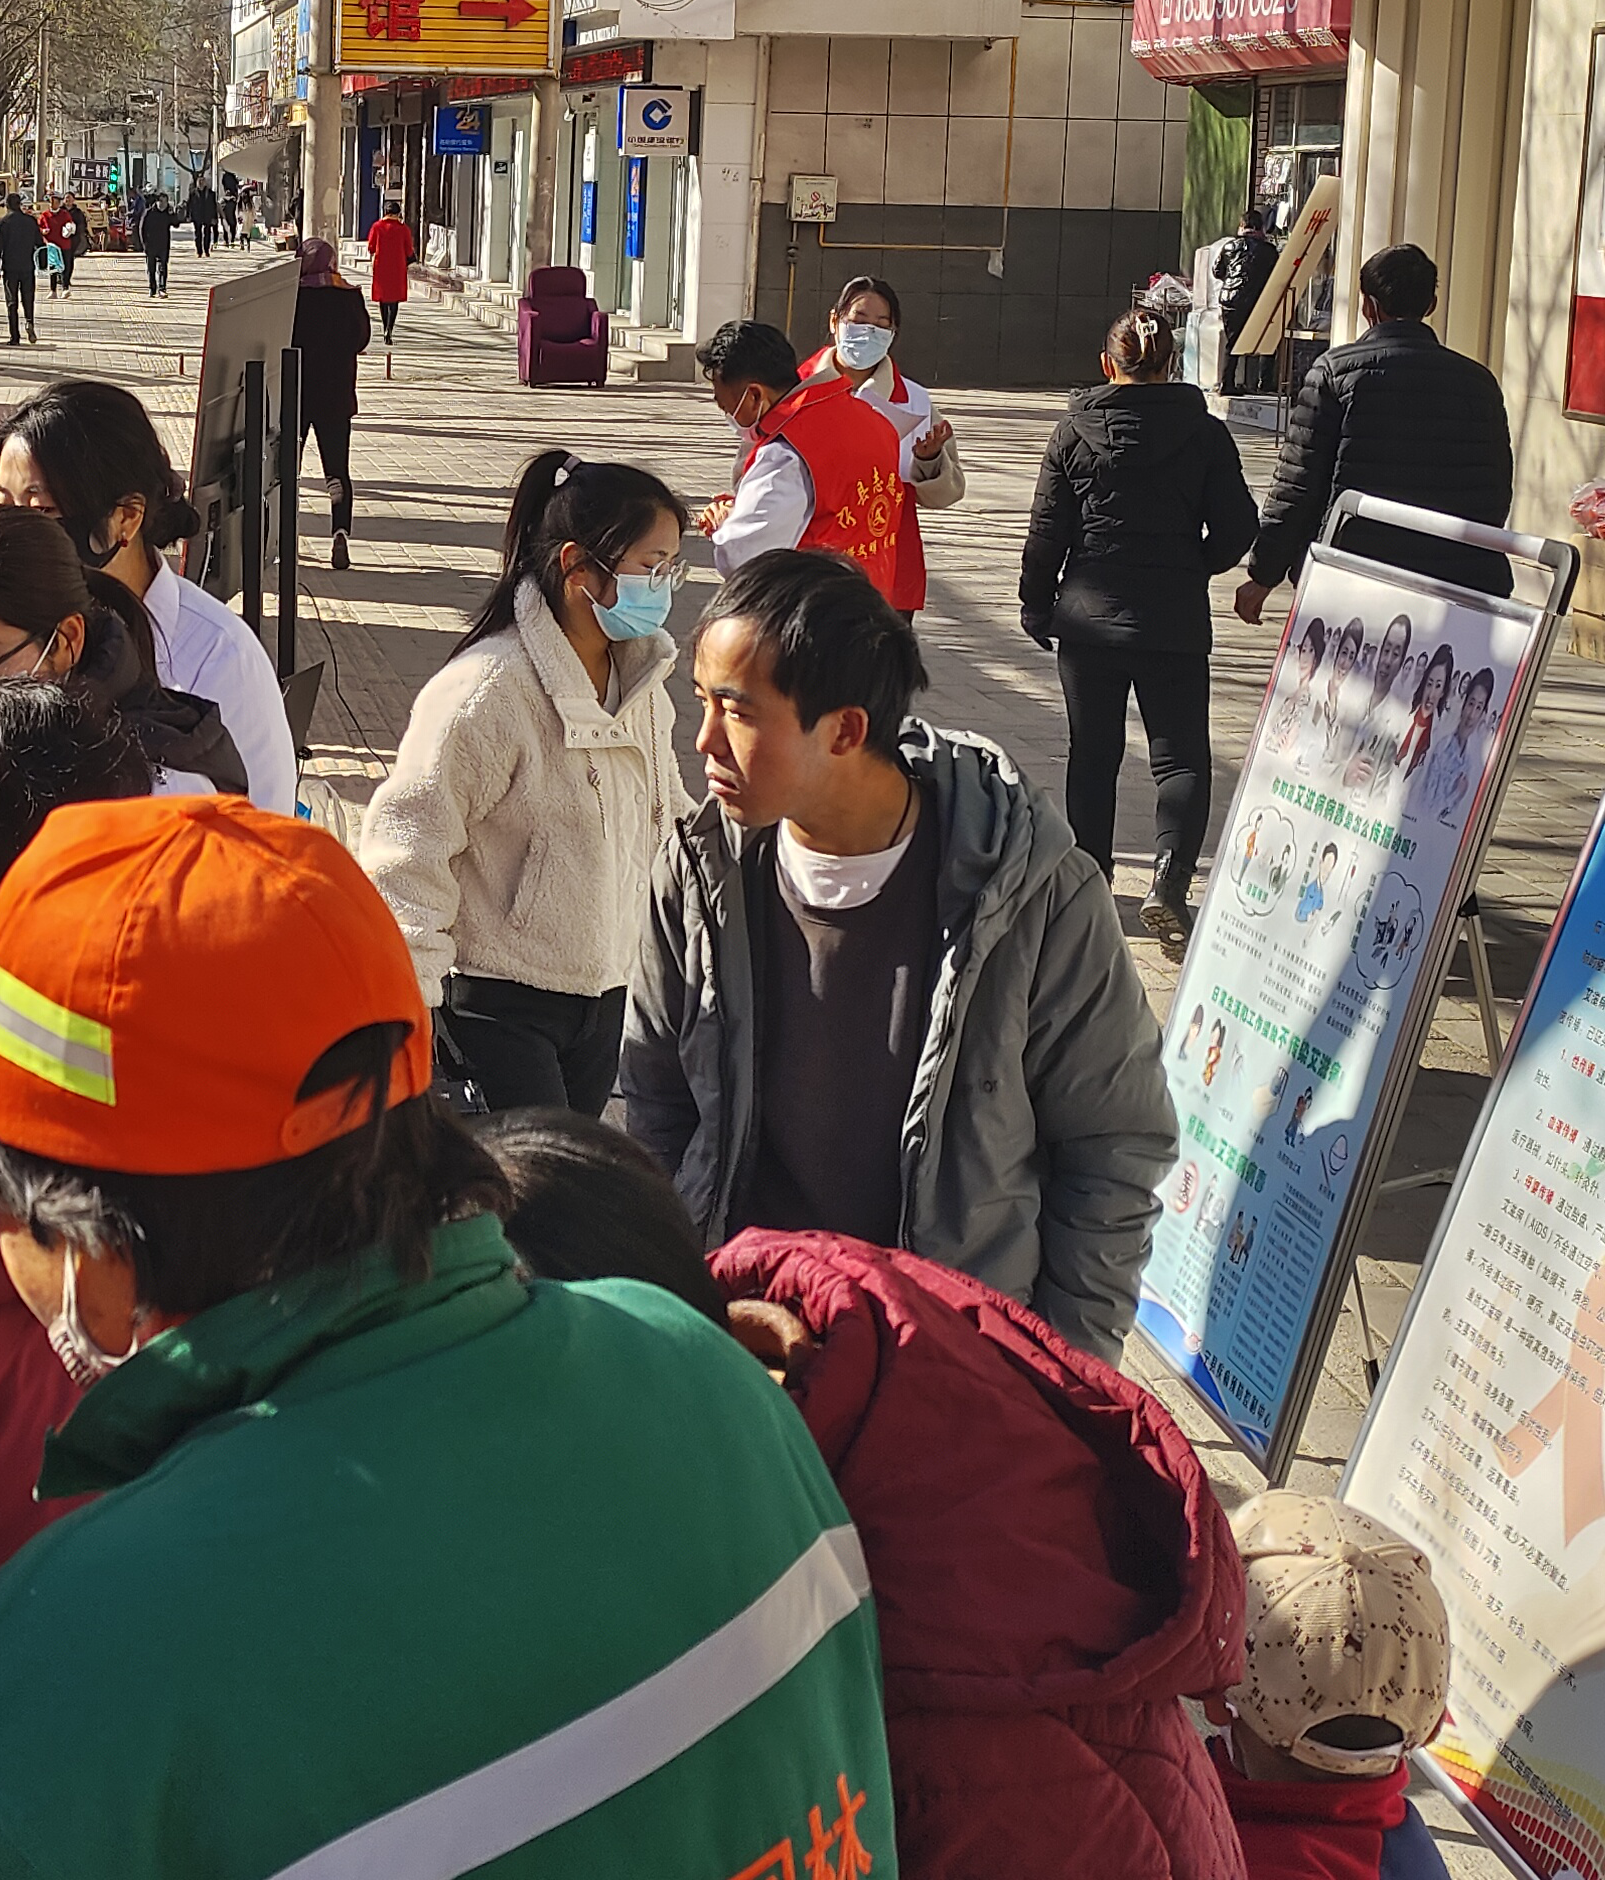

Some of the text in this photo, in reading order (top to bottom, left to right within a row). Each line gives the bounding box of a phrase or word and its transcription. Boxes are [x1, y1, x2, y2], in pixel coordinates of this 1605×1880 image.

[1185, 1114, 1268, 1195] 预防艾滋病病毒
